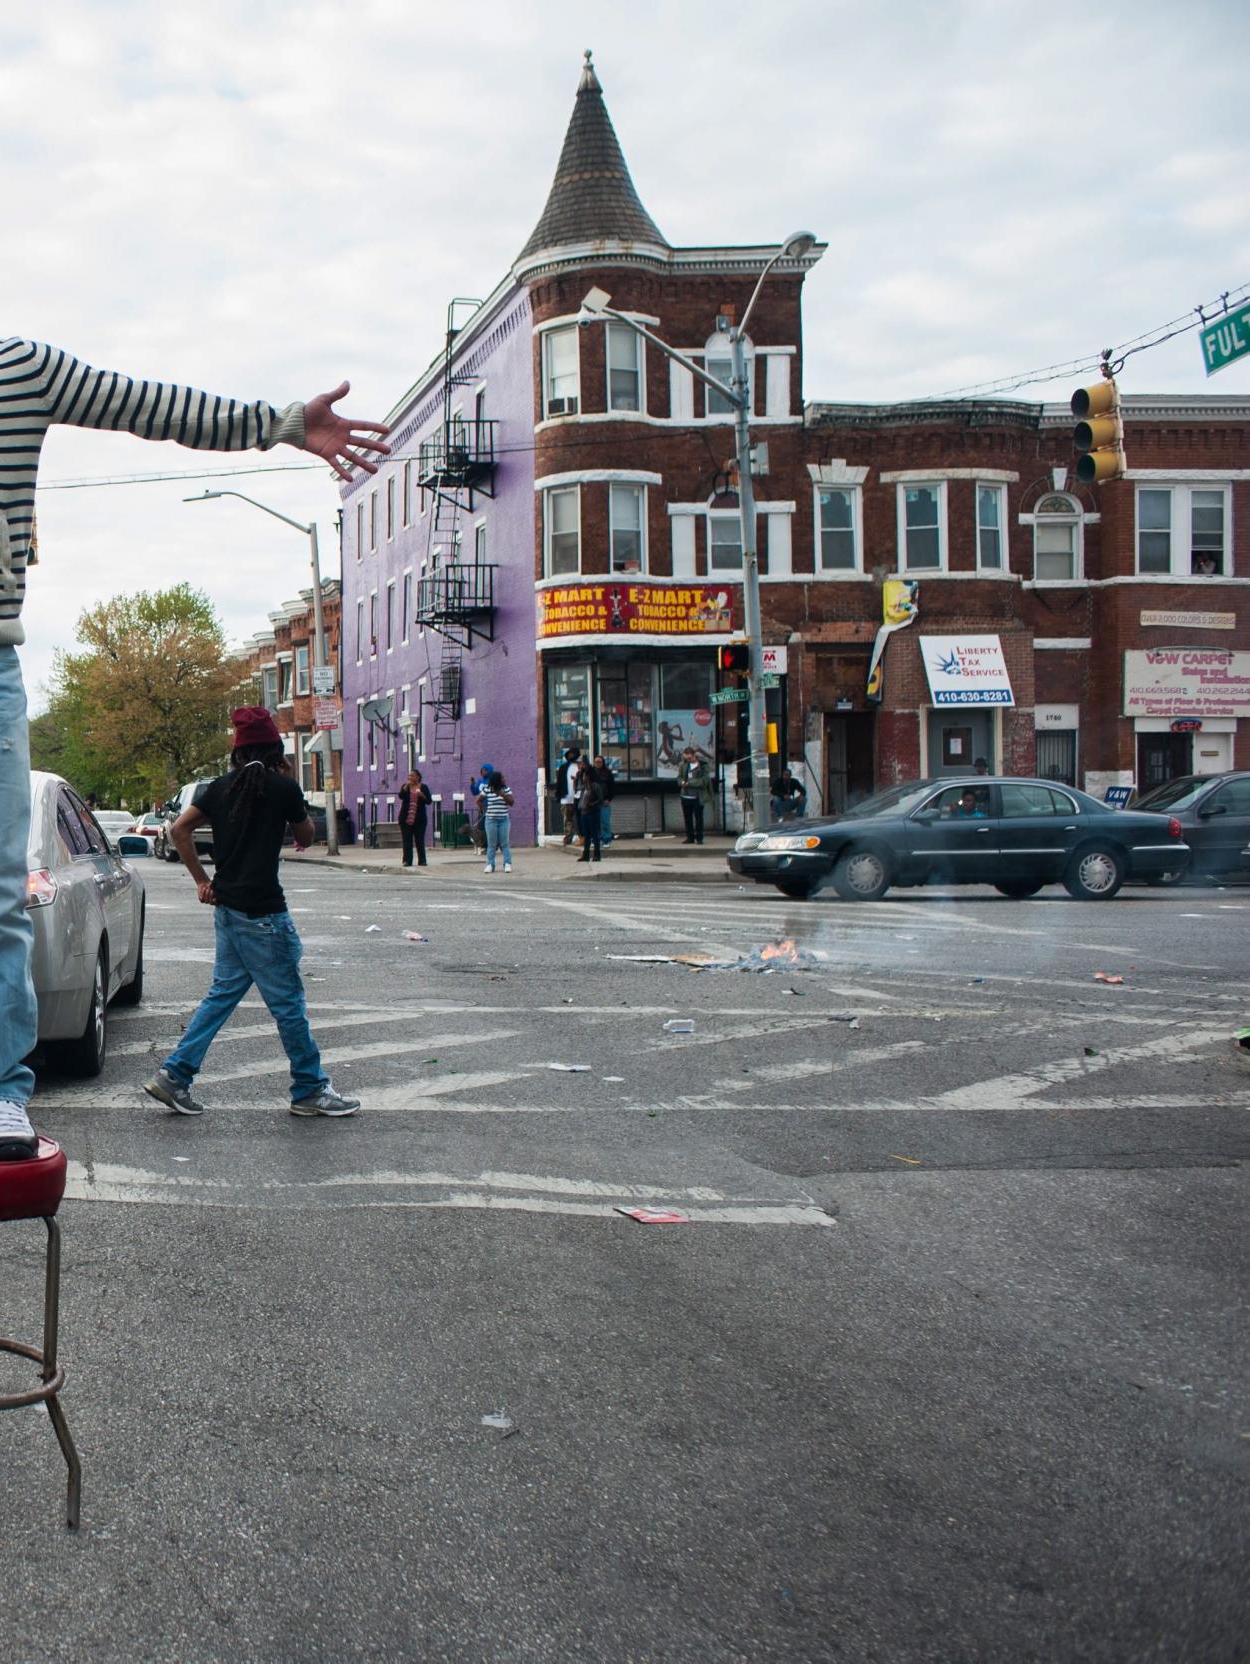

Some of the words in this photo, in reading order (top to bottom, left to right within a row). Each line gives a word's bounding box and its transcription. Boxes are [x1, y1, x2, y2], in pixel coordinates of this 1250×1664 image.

[554, 588, 605, 604] MART
[629, 590, 650, 603] E-Z
[652, 588, 703, 605] MART
[544, 605, 596, 618] TOBACCO
[597, 606, 608, 616] &
[638, 604, 687, 617] TOBACCO
[629, 617, 706, 631] CONVENIENCE
[1181, 653, 1233, 665] CARPET
[717, 692, 740, 702] NORTH
[937, 690, 1009, 702] 410-630-8281
